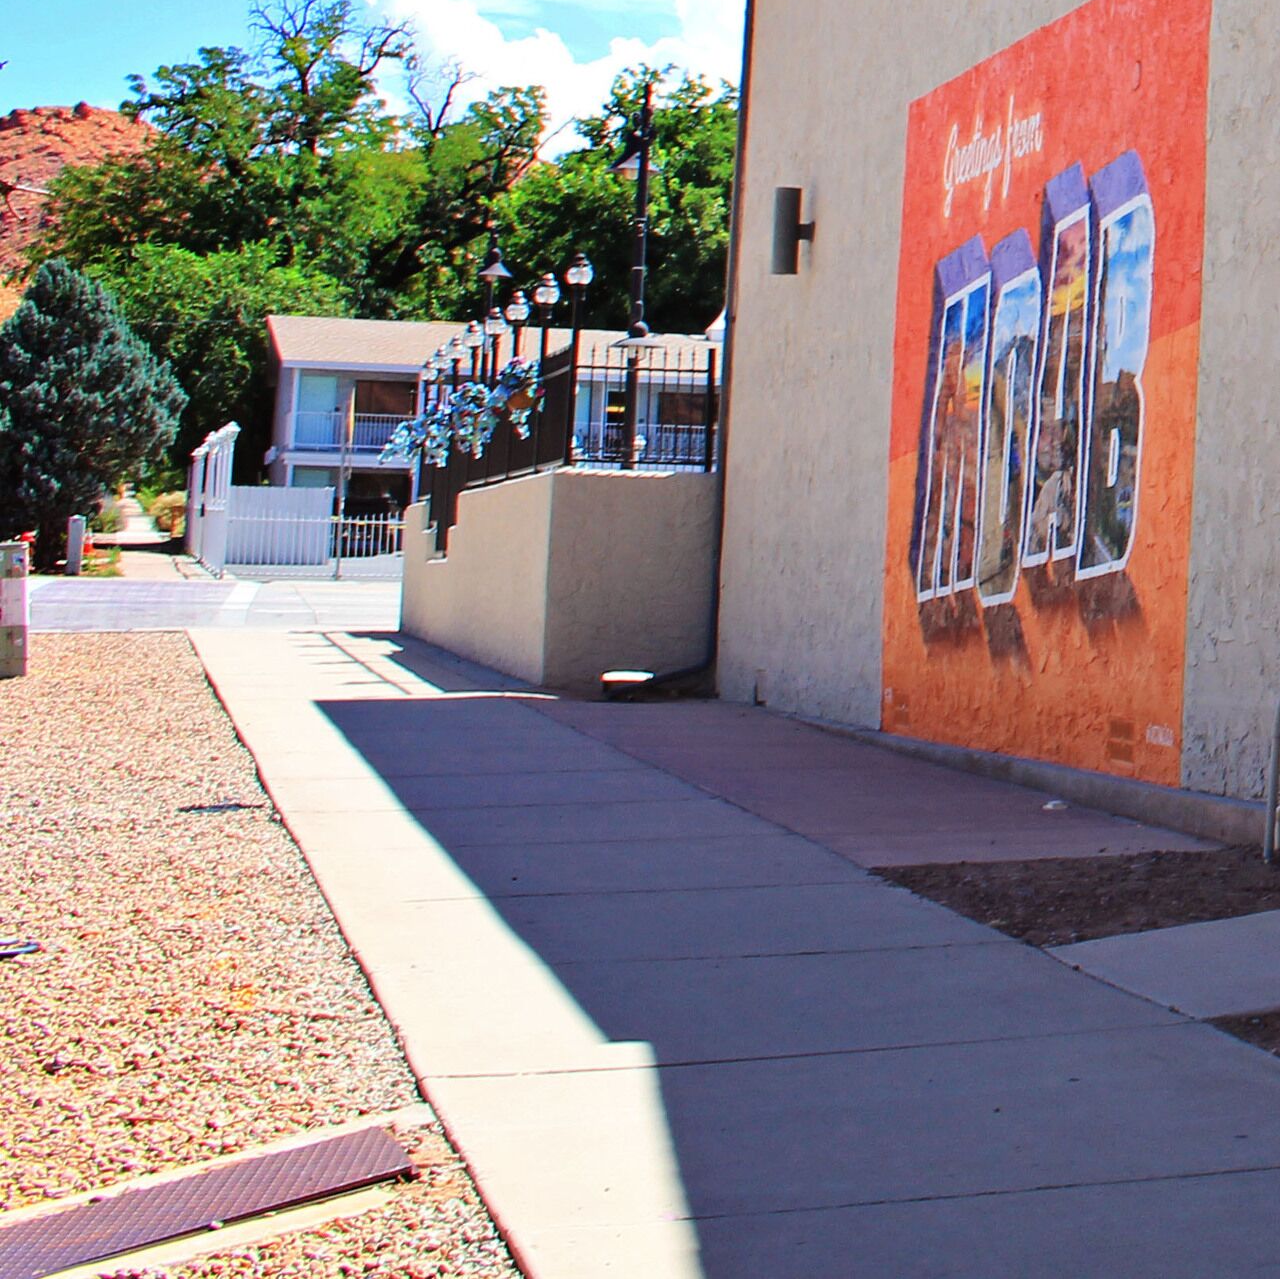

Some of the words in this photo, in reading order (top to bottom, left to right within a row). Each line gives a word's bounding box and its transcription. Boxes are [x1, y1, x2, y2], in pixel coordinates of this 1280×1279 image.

[944, 113, 1003, 217] Greetings
[1002, 95, 1043, 199] from
[915, 180, 1156, 608] MOAB
